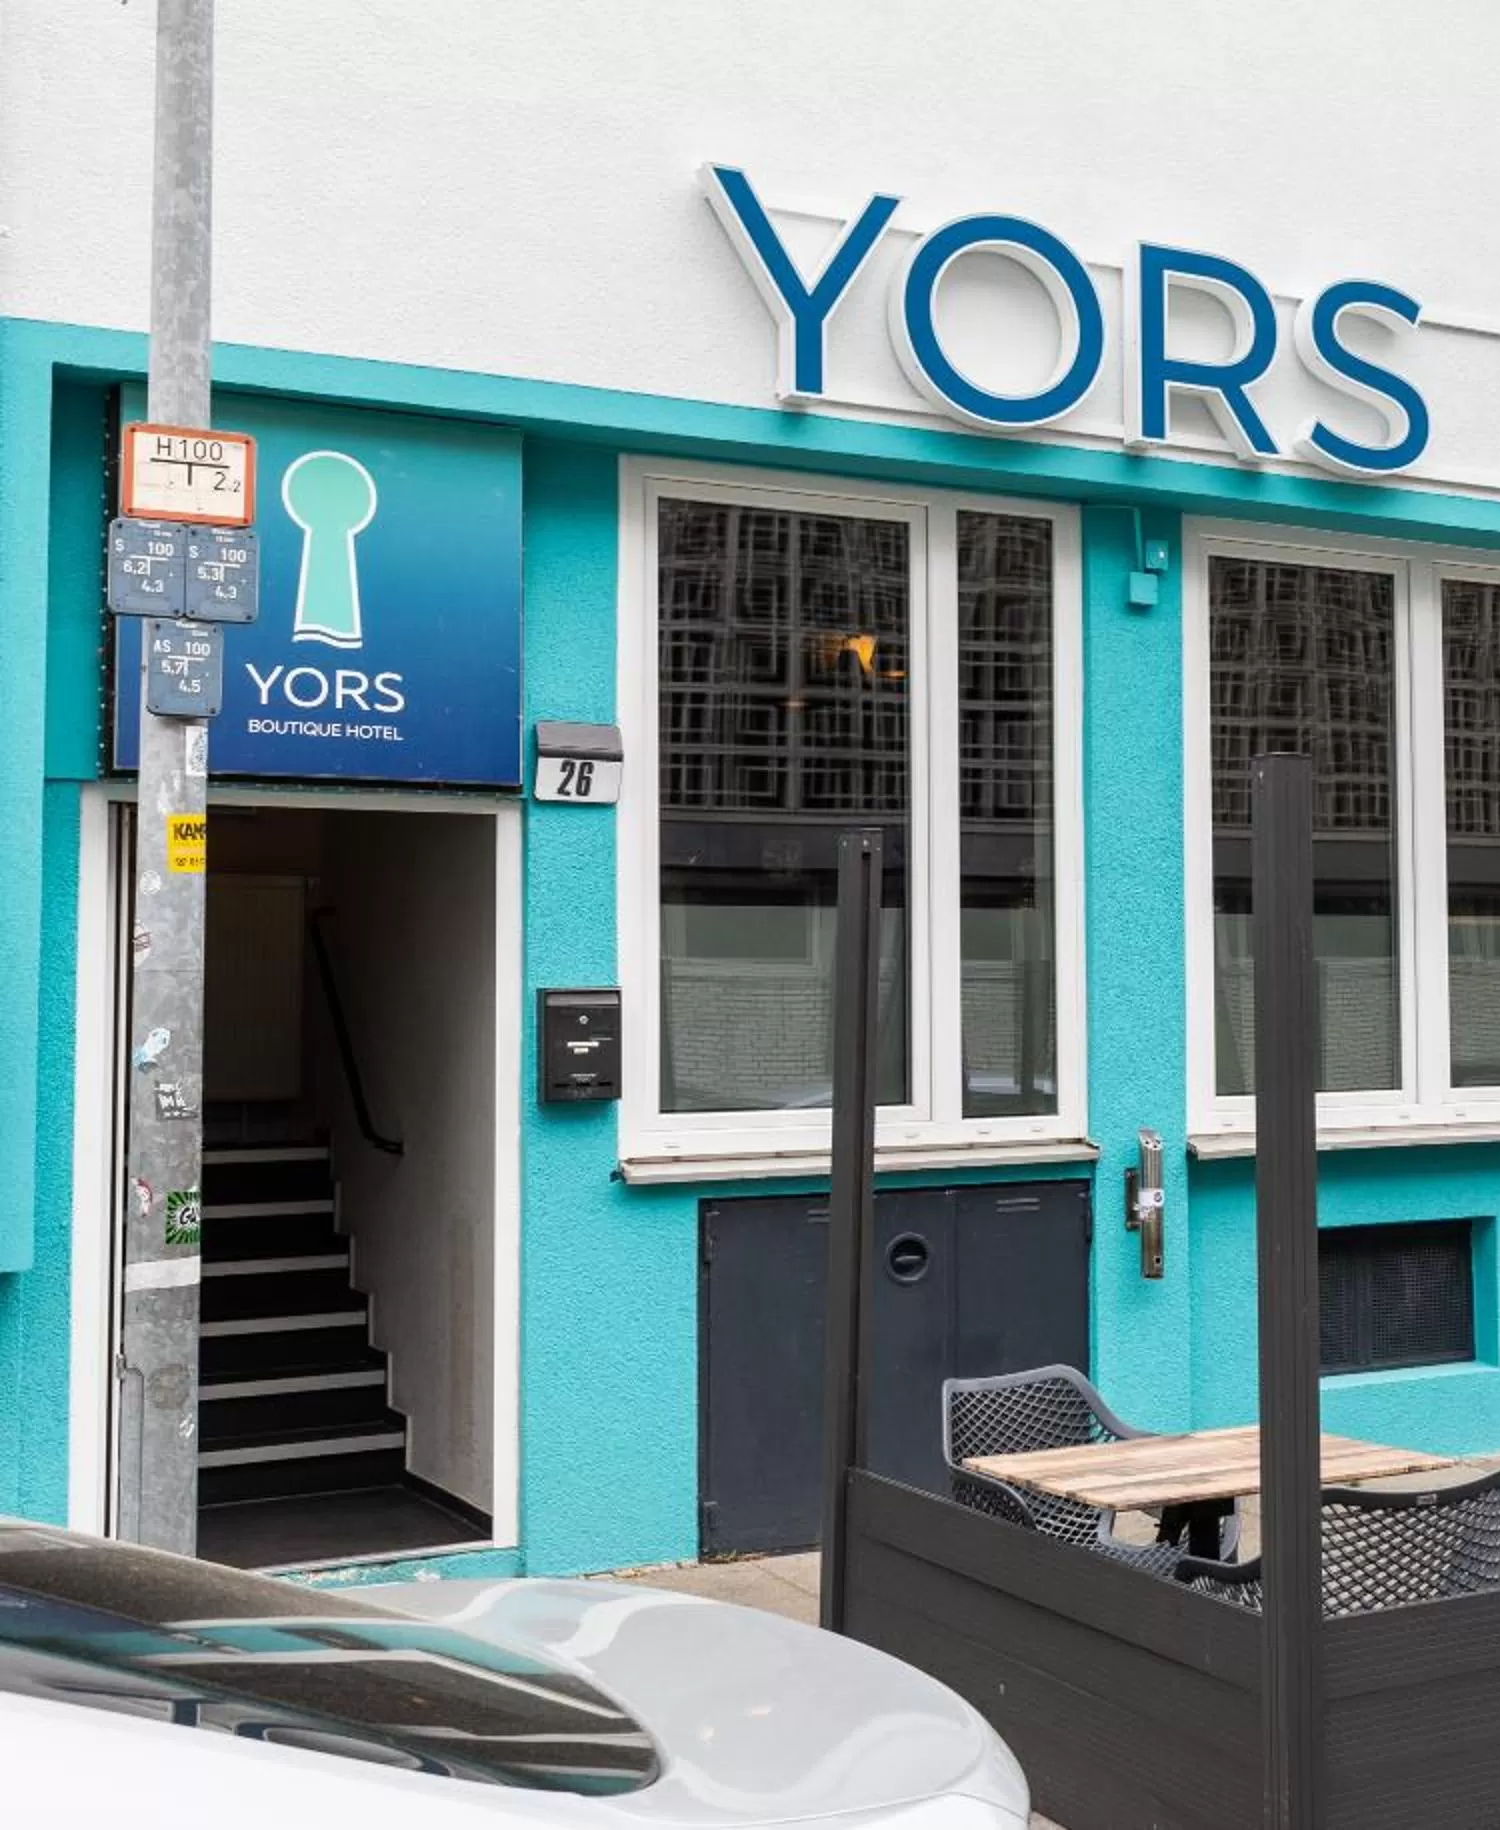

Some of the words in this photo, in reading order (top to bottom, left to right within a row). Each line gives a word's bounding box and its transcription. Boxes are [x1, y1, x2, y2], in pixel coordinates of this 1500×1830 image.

[700, 164, 1430, 476] YORS
[115, 539, 125, 551] S
[148, 541, 174, 556] 100
[188, 546, 199, 559] S
[220, 547, 247, 563] 100
[153, 639, 172, 653] AS
[185, 641, 211, 656] 100
[245, 663, 405, 713] YORS
[249, 719, 342, 737] BOUTIQUE
[346, 724, 404, 741] HOTEL
[557, 759, 594, 796] 26
